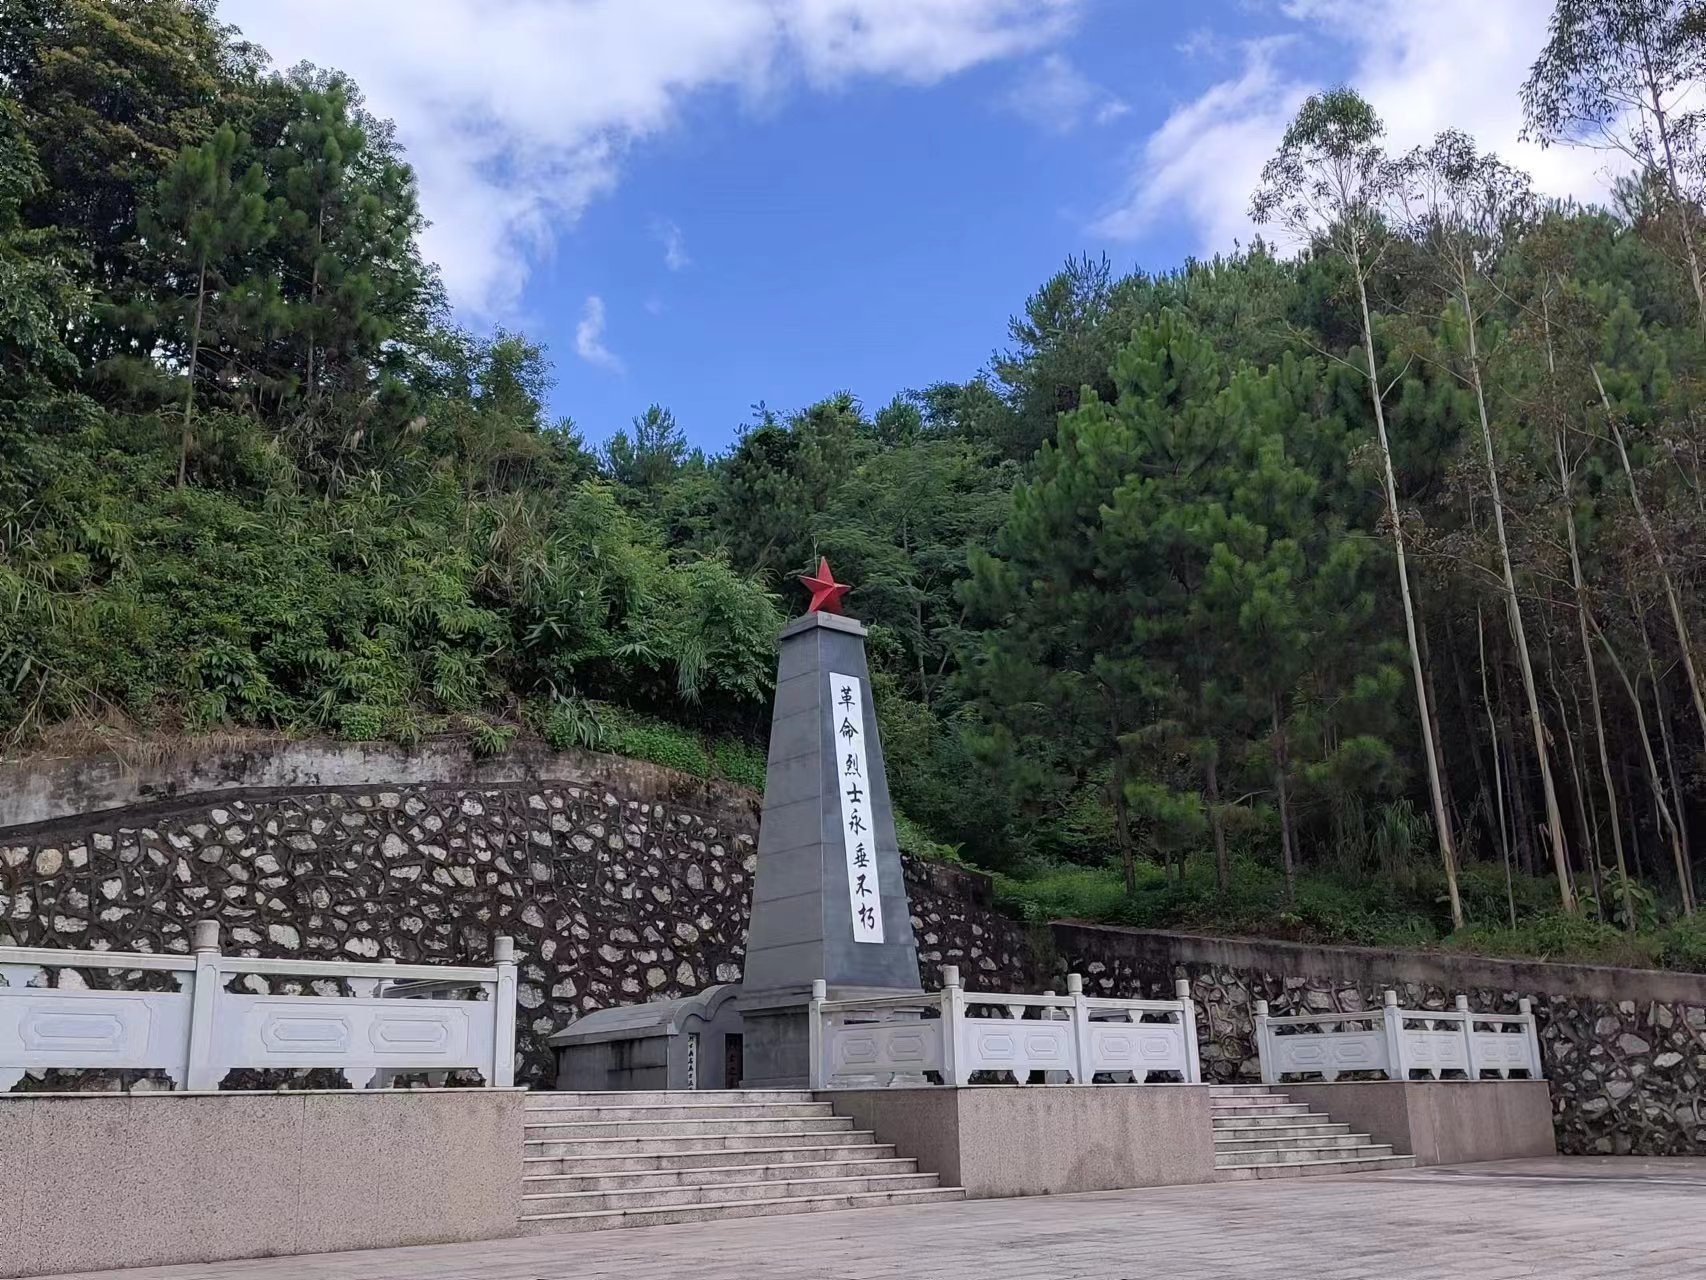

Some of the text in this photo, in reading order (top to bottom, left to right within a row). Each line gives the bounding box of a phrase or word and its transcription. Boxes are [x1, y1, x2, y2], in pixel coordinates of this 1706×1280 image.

[838, 686, 875, 929] 革命烈士永垂不朽
